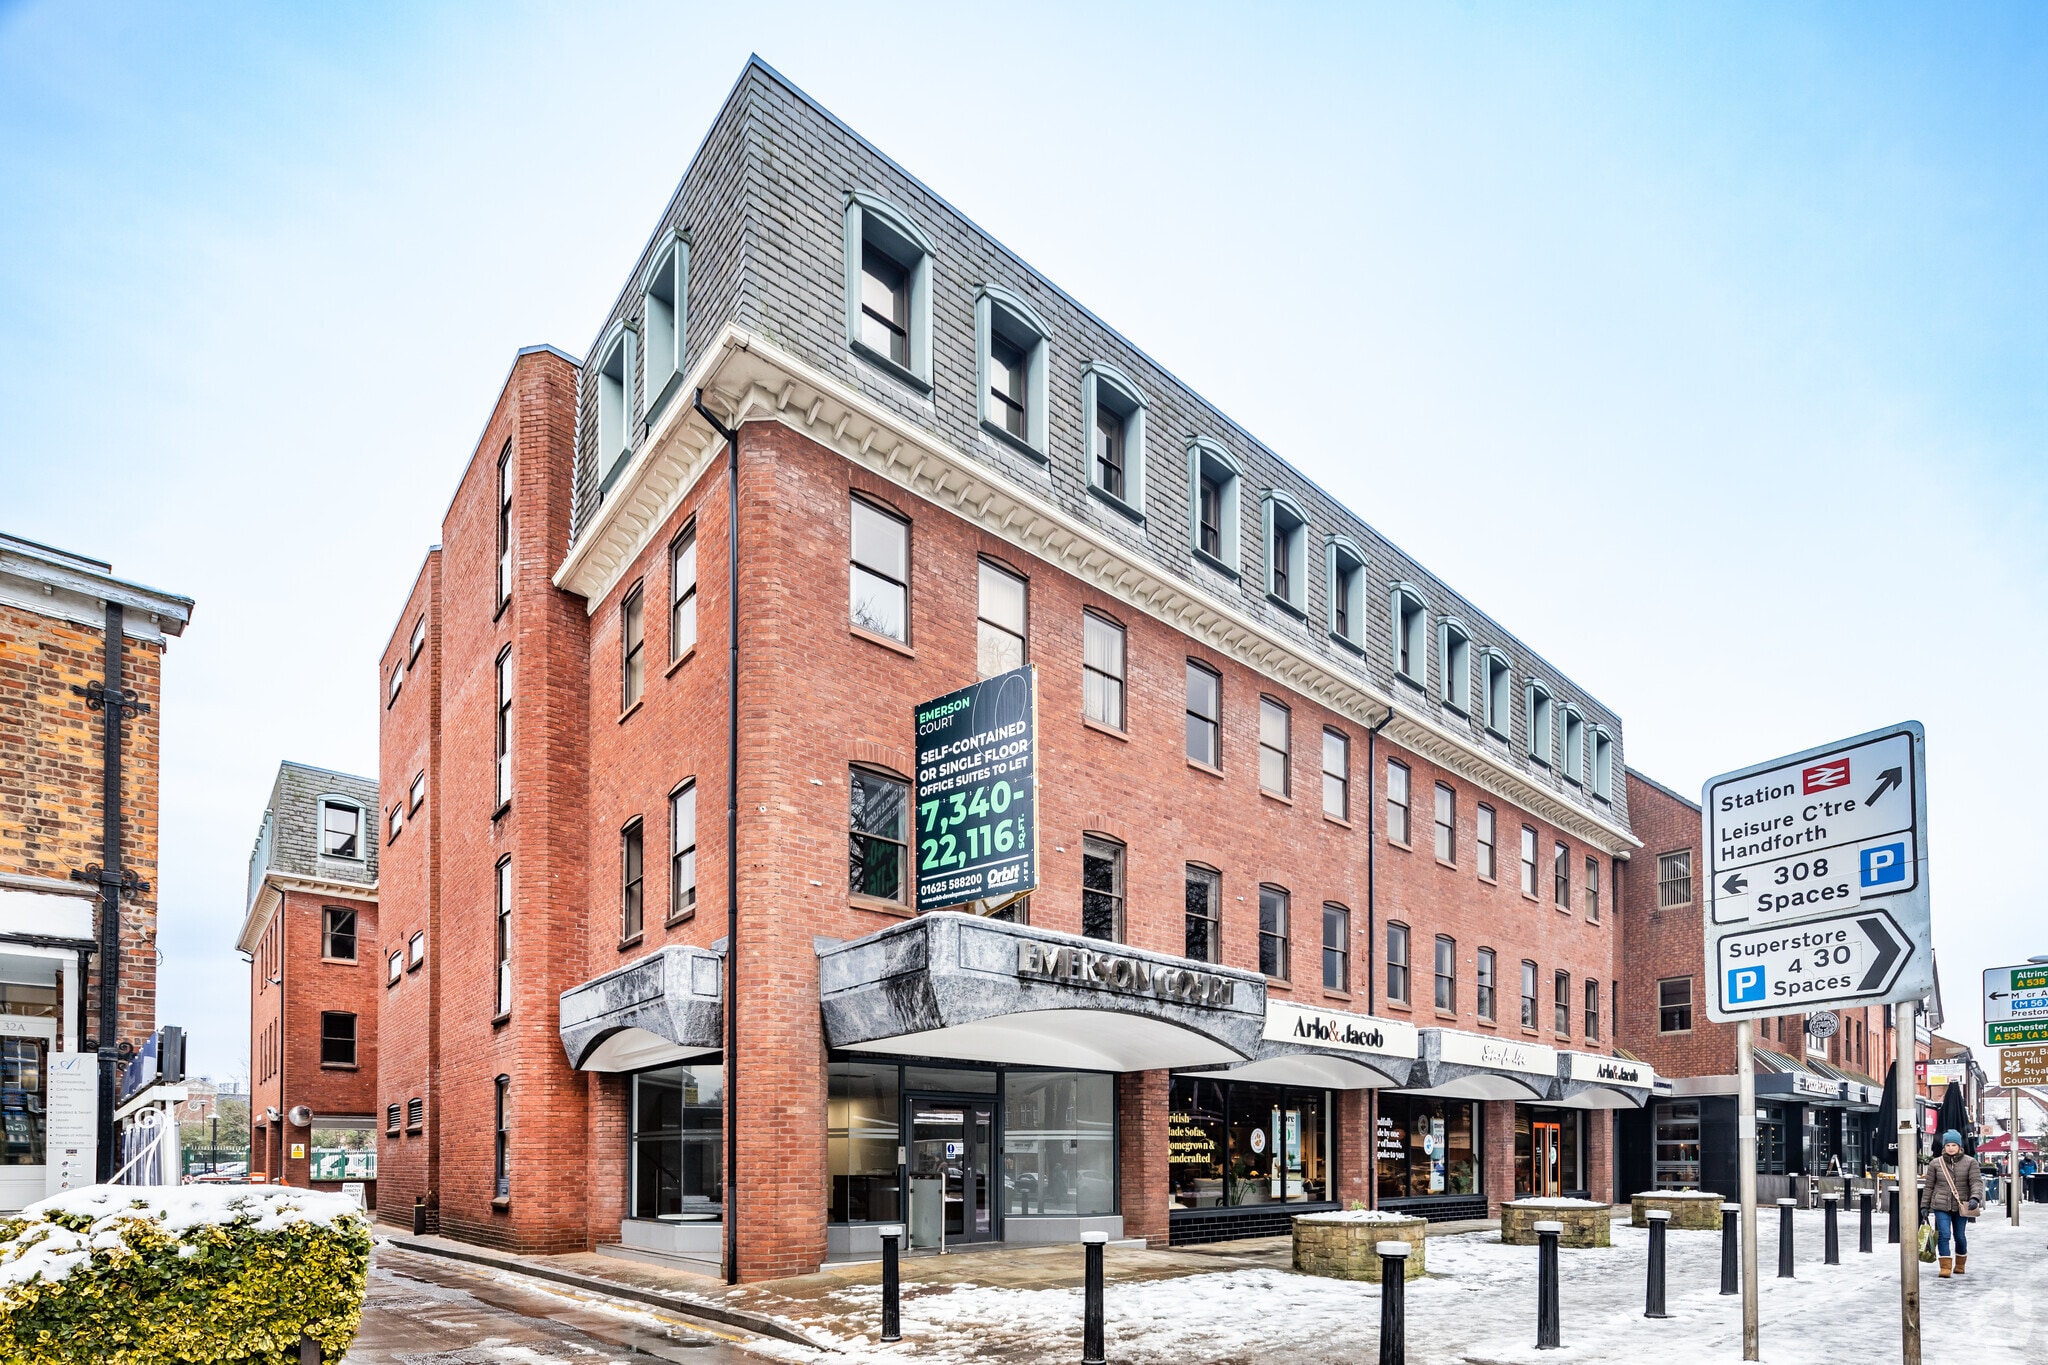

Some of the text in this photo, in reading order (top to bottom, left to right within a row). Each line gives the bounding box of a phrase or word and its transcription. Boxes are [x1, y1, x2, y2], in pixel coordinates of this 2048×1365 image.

[919, 697, 970, 724] EMERSON
[919, 715, 954, 736] COURT
[921, 721, 1026, 765] SELF-CONTAINED
[920, 739, 1028, 783] OR SINGLE FLOOR
[920, 756, 1028, 797] OFFICE SUITES TO LET
[921, 780, 1024, 834] 7,340-
[1721, 783, 1795, 812] Station
[1722, 799, 1856, 842] Leisure C'tre
[921, 819, 1014, 870] 22,116
[1722, 825, 1827, 861] Handforth
[987, 864, 1020, 884] Orbit
[1774, 858, 1829, 885] 308
[1869, 849, 1895, 882] P
[921, 873, 982, 896] 01625 588200
[1757, 882, 1850, 912] Spaces
[1729, 930, 1847, 958] Superstore
[1018, 939, 1235, 1006] EMERSON COURT
[1736, 970, 1757, 999] P
[2026, 977, 2046, 987] 538
[1773, 975, 1852, 997] Spaces
[3, 1022, 26, 1031] 32A
[1994, 1023, 2048, 1033] Manchester
[1995, 1033, 2002, 1041] A
[2004, 1032, 2023, 1040] 538
[2041, 1030, 2048, 1038] 3
[2003, 1048, 2048, 1058] Quarry B
[2025, 1056, 2042, 1065] Mill
[2004, 1076, 2042, 1084] Country
[1169, 1112, 1192, 1124] ritish-
[1168, 1126, 1207, 1138] ade Sofas,
[1168, 1140, 1215, 1152] omegrown &
[1168, 1153, 1211, 1163] andcrafted
